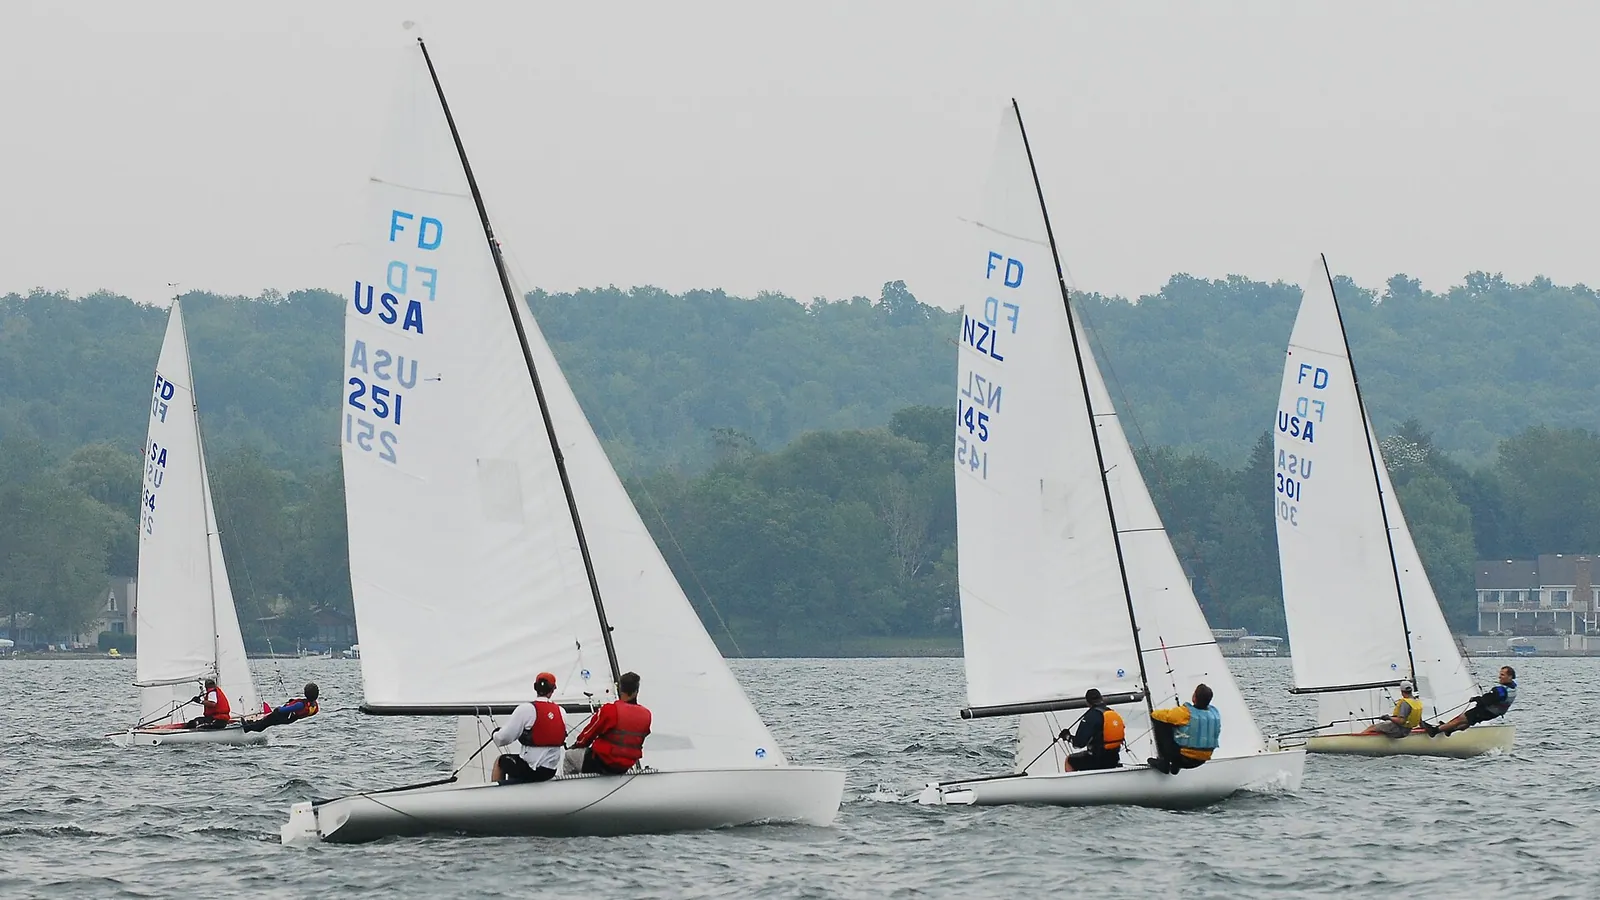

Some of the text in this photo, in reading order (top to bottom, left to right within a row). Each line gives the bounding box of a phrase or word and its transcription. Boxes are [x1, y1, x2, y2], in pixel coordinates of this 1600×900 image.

[389, 210, 443, 250] FD
[986, 251, 1024, 288] FD
[354, 281, 424, 334] USA
[963, 315, 1003, 361] NZL
[155, 374, 175, 401] FD
[1298, 364, 1329, 390] FD
[348, 377, 402, 425] 251
[958, 399, 989, 442] 145
[1278, 411, 1314, 443] USA
[1276, 473, 1301, 501] 301
